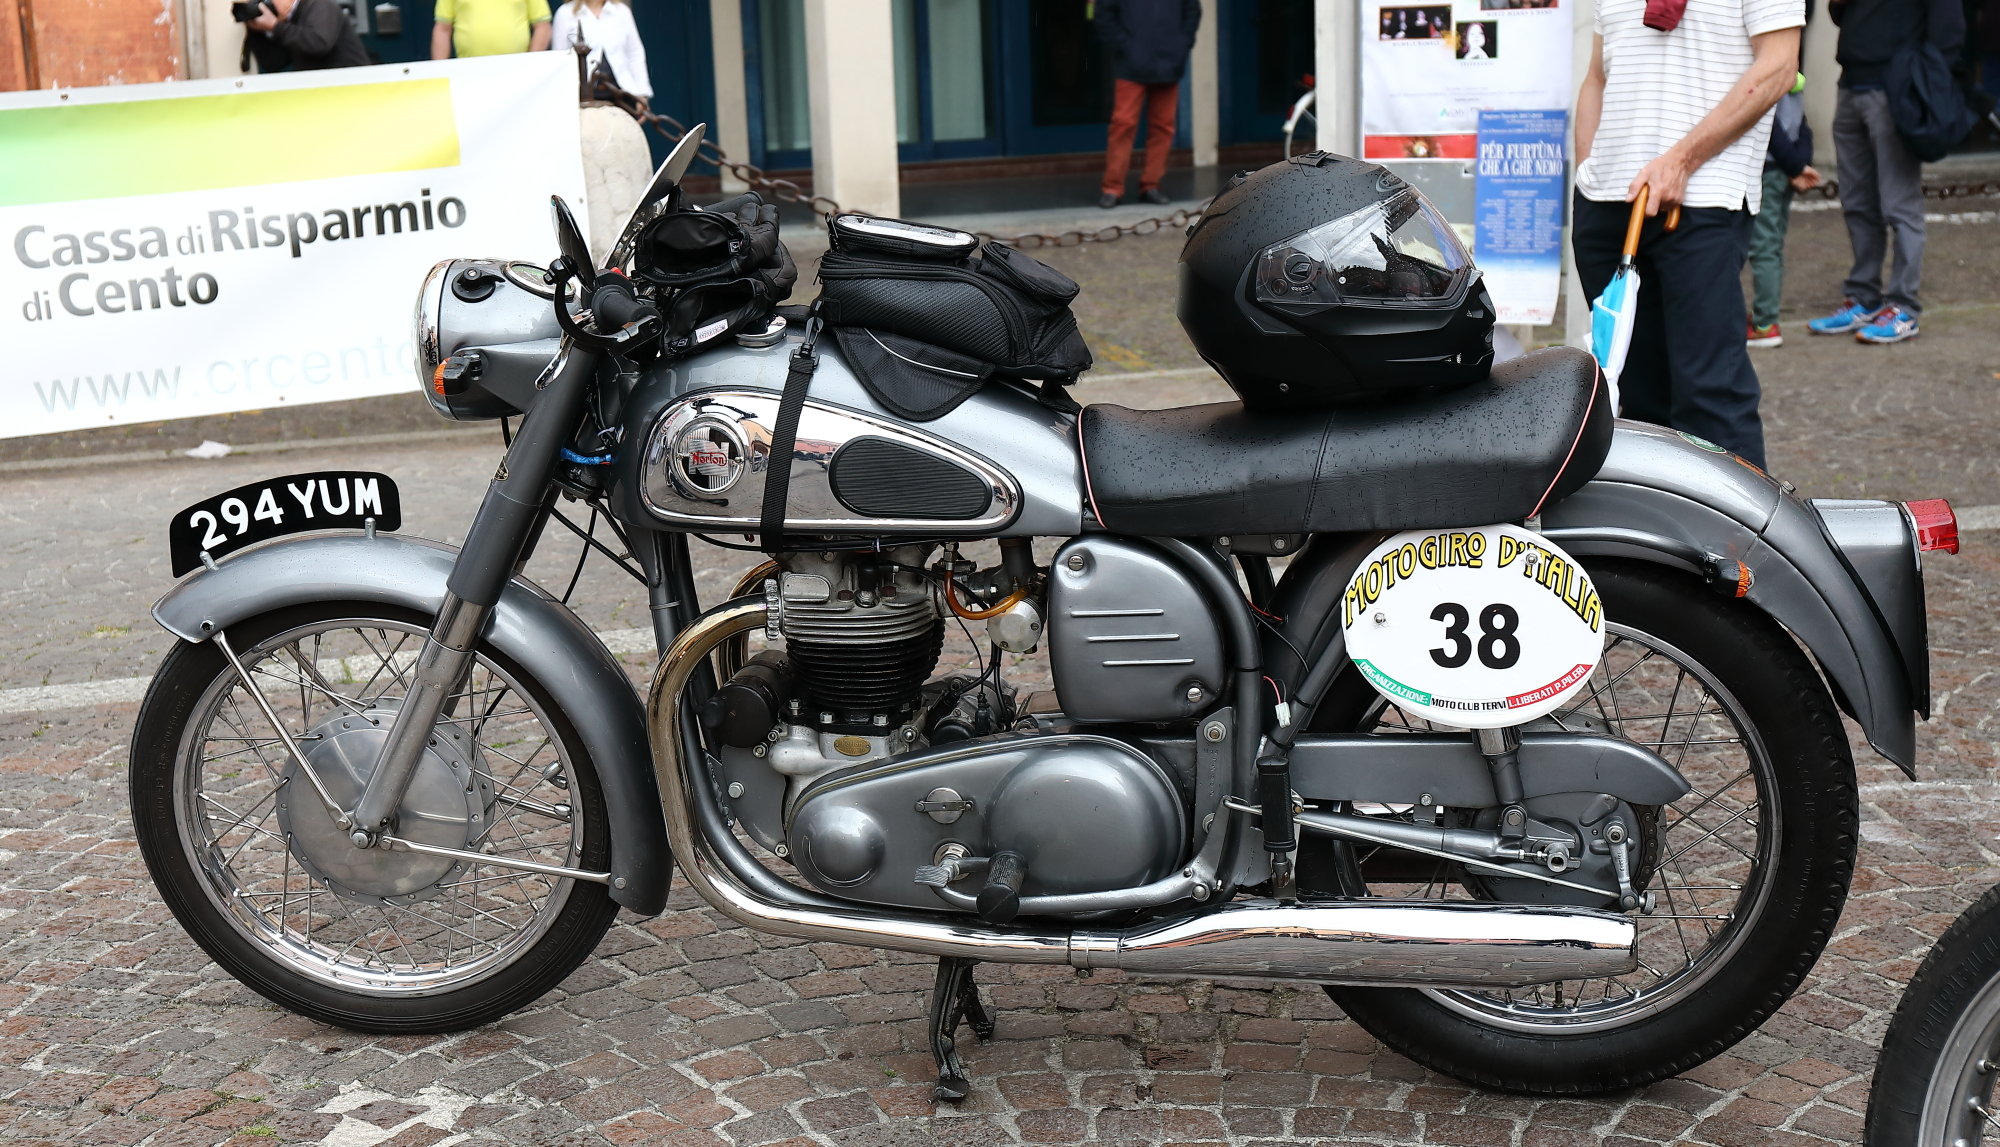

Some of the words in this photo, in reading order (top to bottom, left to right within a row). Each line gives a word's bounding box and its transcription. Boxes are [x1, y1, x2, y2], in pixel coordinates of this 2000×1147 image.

[1480, 160, 1500, 175] CHE
[1502, 160, 1510, 175] A
[14, 224, 169, 270] Cassa
[175, 225, 206, 256] di
[208, 187, 467, 259] Risparmio
[22, 290, 53, 322] di
[58, 265, 219, 317] Cento
[690, 451, 728, 467] Norton
[189, 487, 285, 551] 294
[287, 477, 383, 519] YUM
[1428, 602, 1521, 670] 38
[1359, 661, 1429, 704] ORGANIZZAZIONE:
[1431, 698, 1455, 710] MOTO
[1457, 699, 1480, 711] CLUB
[1481, 700, 1507, 711] TERNI
[1508, 686, 1555, 708] L.LIBERATI
[1554, 665, 1586, 692] P.PILERI
